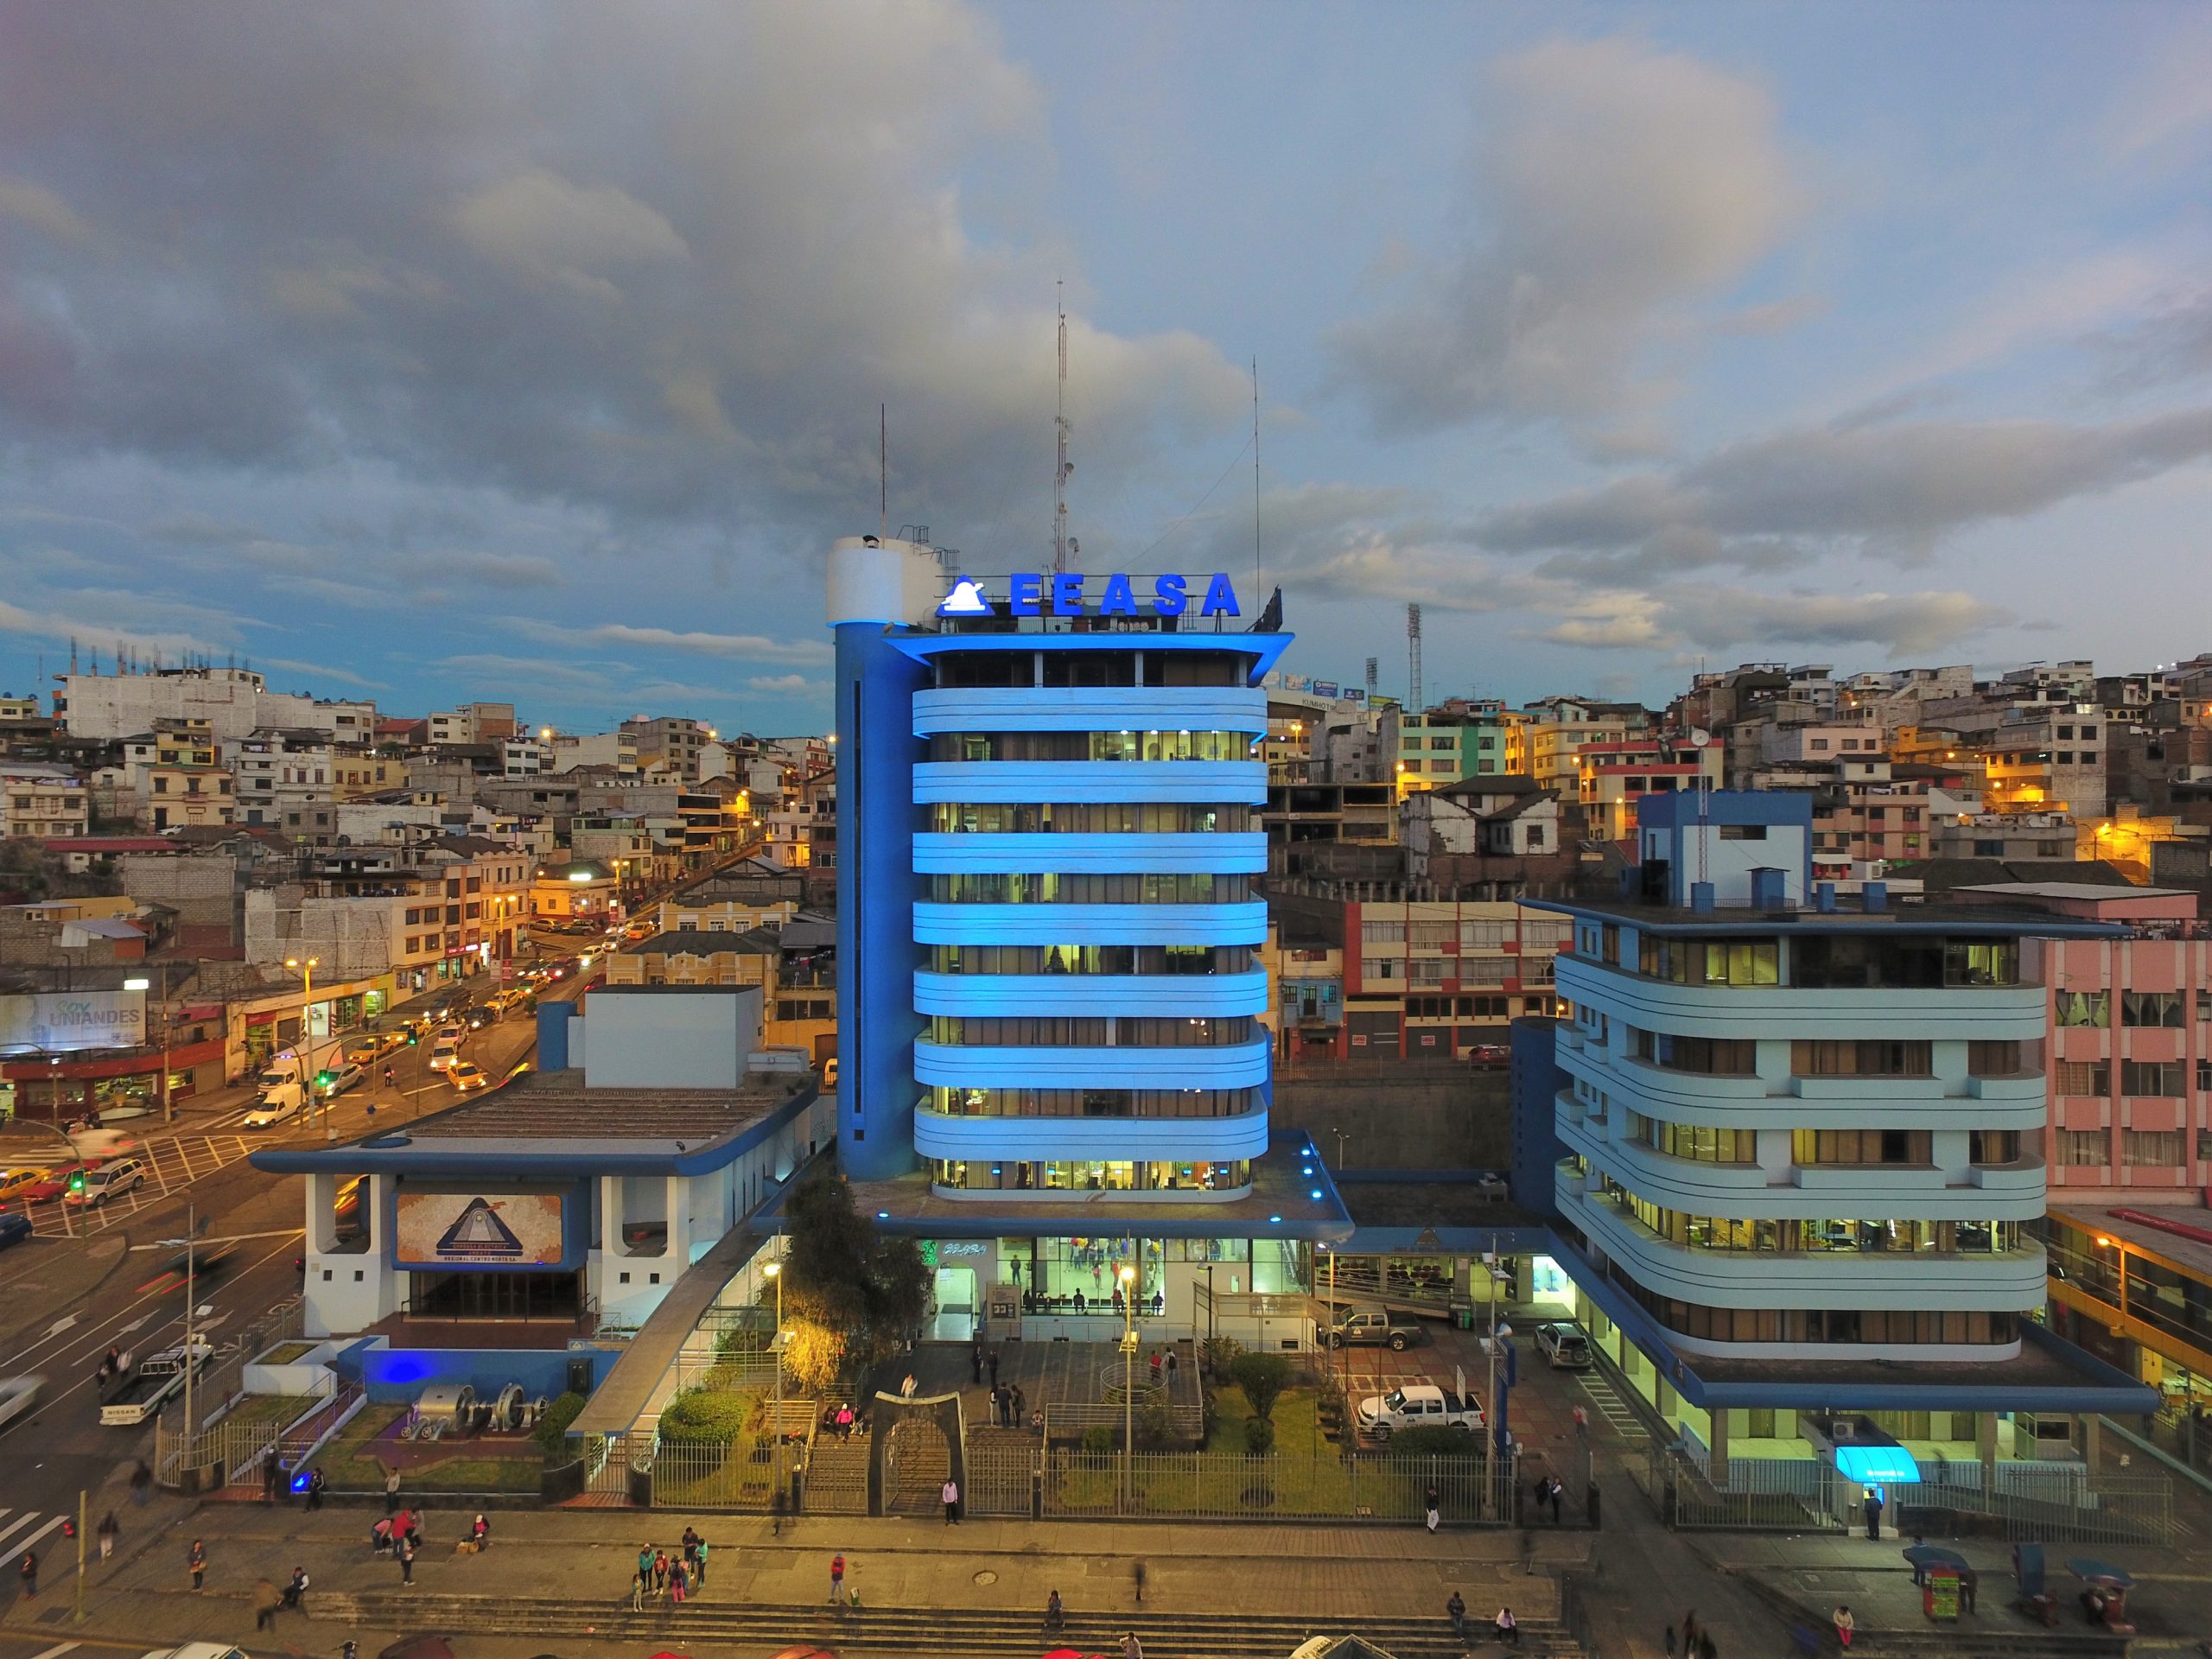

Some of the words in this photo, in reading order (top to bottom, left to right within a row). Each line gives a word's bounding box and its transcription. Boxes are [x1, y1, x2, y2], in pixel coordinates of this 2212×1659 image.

[1010, 573, 1241, 617] EEASA
[1302, 698, 1326, 709] KUMHO
[50, 1009, 140, 1027] UNIANDES
